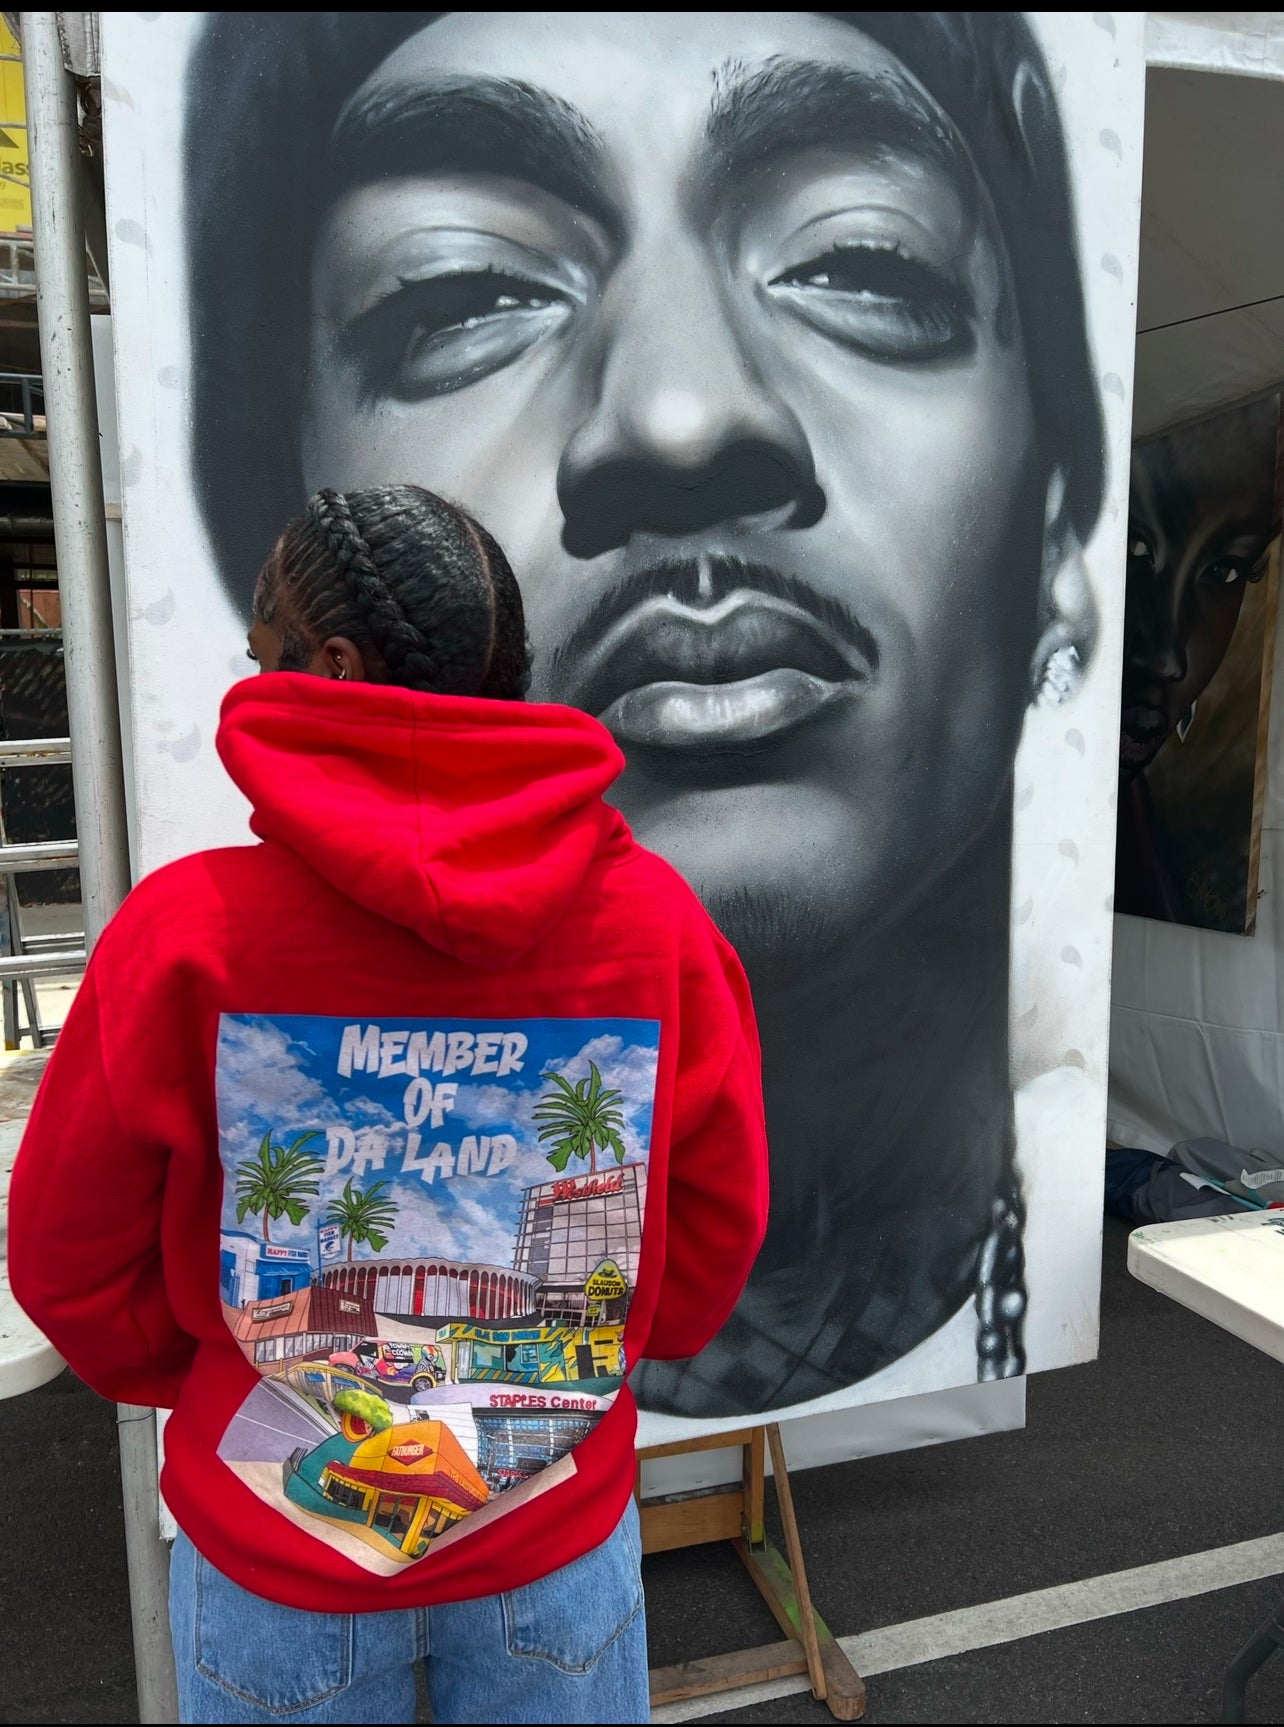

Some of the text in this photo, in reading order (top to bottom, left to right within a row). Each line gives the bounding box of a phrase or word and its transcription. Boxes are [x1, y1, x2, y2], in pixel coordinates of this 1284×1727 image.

[337, 1024, 528, 1078] MEMBER
[403, 1077, 459, 1129] OF
[325, 1126, 517, 1183] DA LAND
[588, 1286, 624, 1296] DONUTS
[592, 1279, 621, 1287] SLAUSON
[490, 1394, 597, 1410] STAPLES Center
[391, 1444, 425, 1457] FATBURGER
